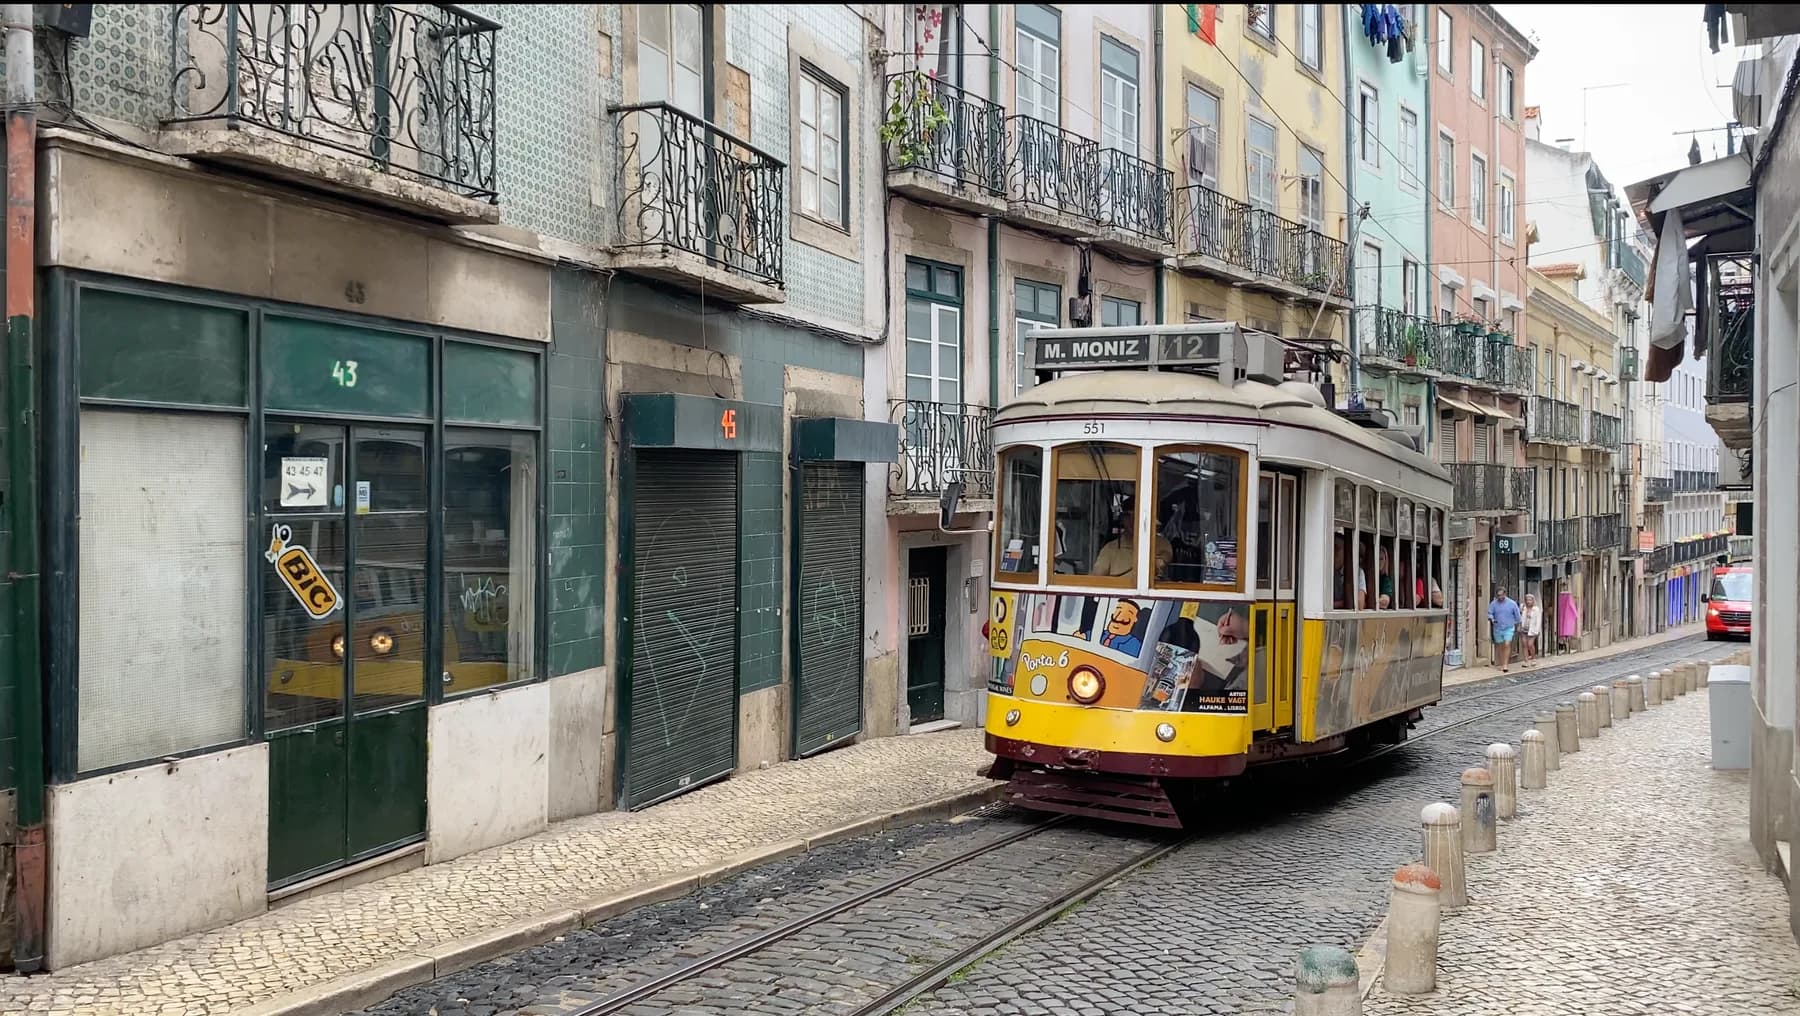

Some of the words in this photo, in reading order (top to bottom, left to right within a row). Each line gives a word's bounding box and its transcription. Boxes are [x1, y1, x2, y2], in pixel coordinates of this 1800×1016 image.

[1044, 343, 1066, 359] M.
[1072, 339, 1140, 358] MONIZ
[332, 360, 358, 387] 43
[721, 409, 736, 439] 45
[1083, 423, 1105, 434] 551
[286, 466, 297, 477] 43
[299, 466, 311, 477] 45
[313, 466, 324, 477] 47
[1499, 539, 1509, 549] 69
[1022, 653, 1056, 671] Porta
[1058, 650, 1069, 668] 6
[1199, 696, 1226, 704] HAUKE
